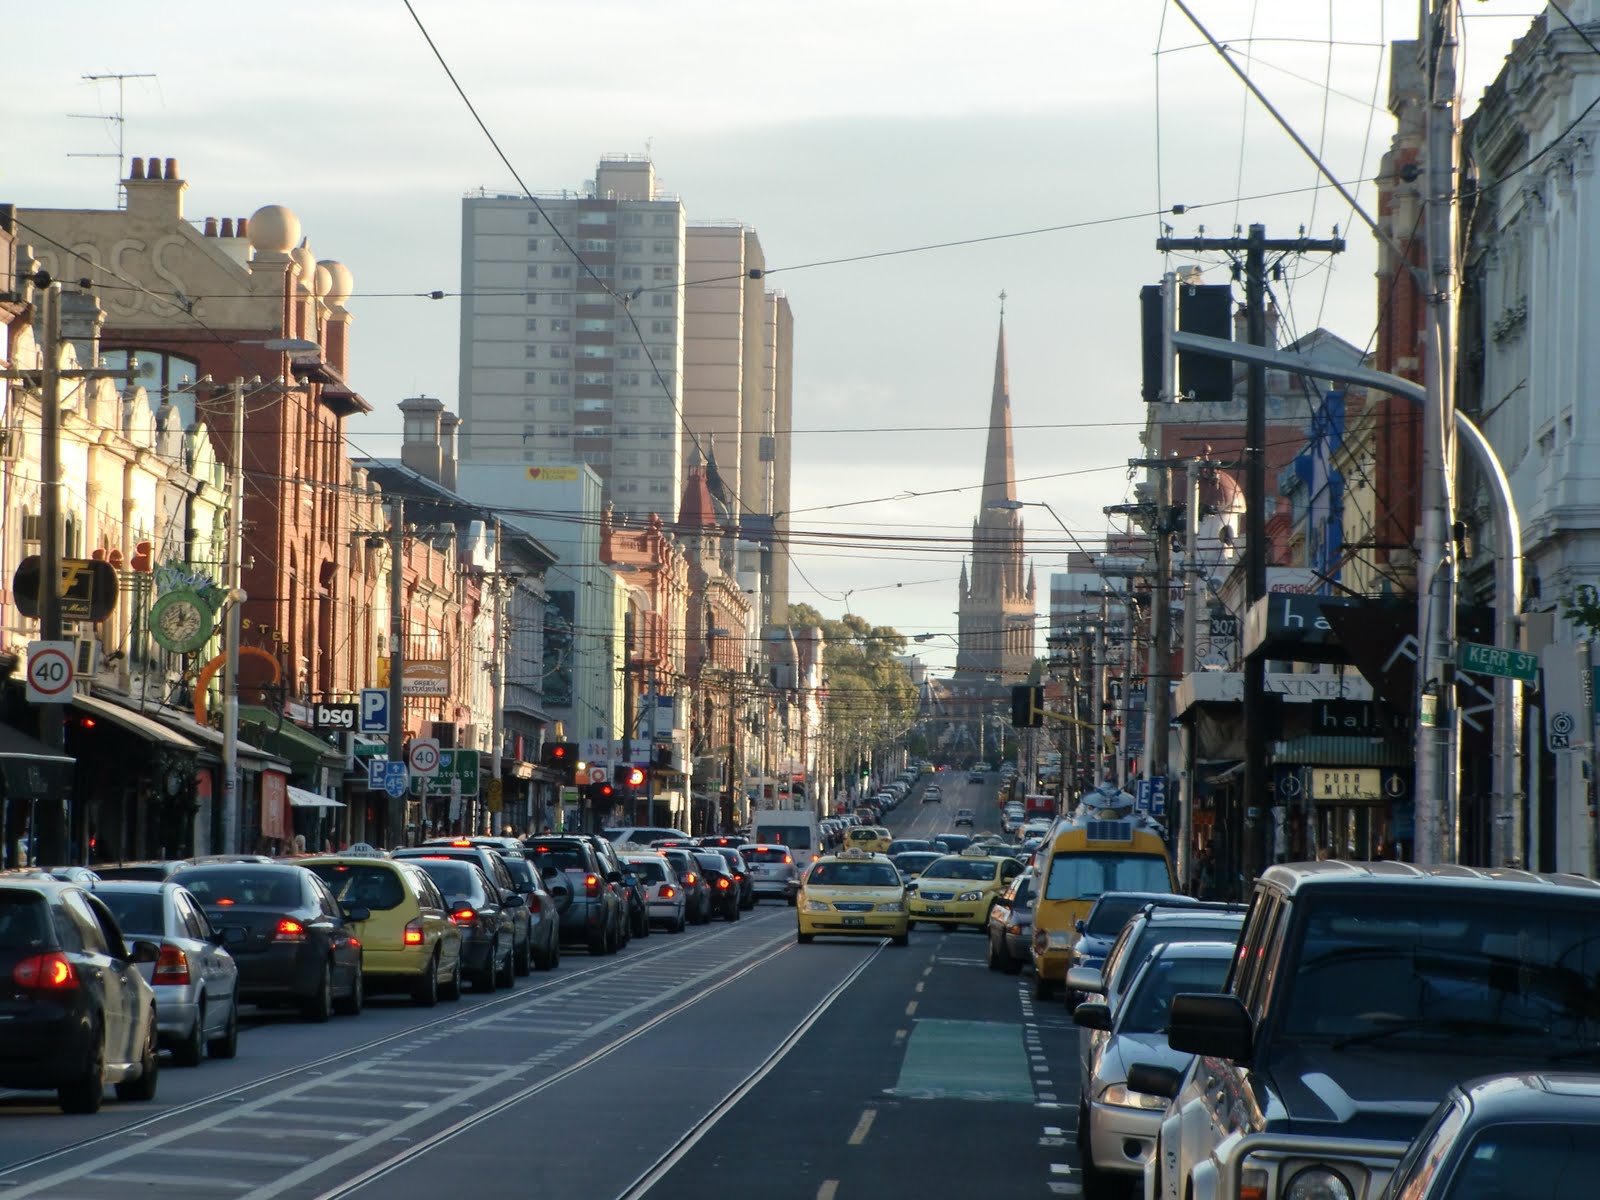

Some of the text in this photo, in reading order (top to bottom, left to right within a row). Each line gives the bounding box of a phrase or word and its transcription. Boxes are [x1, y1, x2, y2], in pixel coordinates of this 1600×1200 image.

[1211, 619, 1234, 634] 307
[1469, 646, 1535, 671] KERR ST
[35, 662, 64, 682] 40
[365, 692, 385, 720] P
[318, 707, 353, 729] bsg
[415, 751, 434, 764] 40
[373, 762, 384, 777] P
[387, 777, 403, 790] 45
[1324, 784, 1360, 795] MILK
[1152, 792, 1165, 812] P
